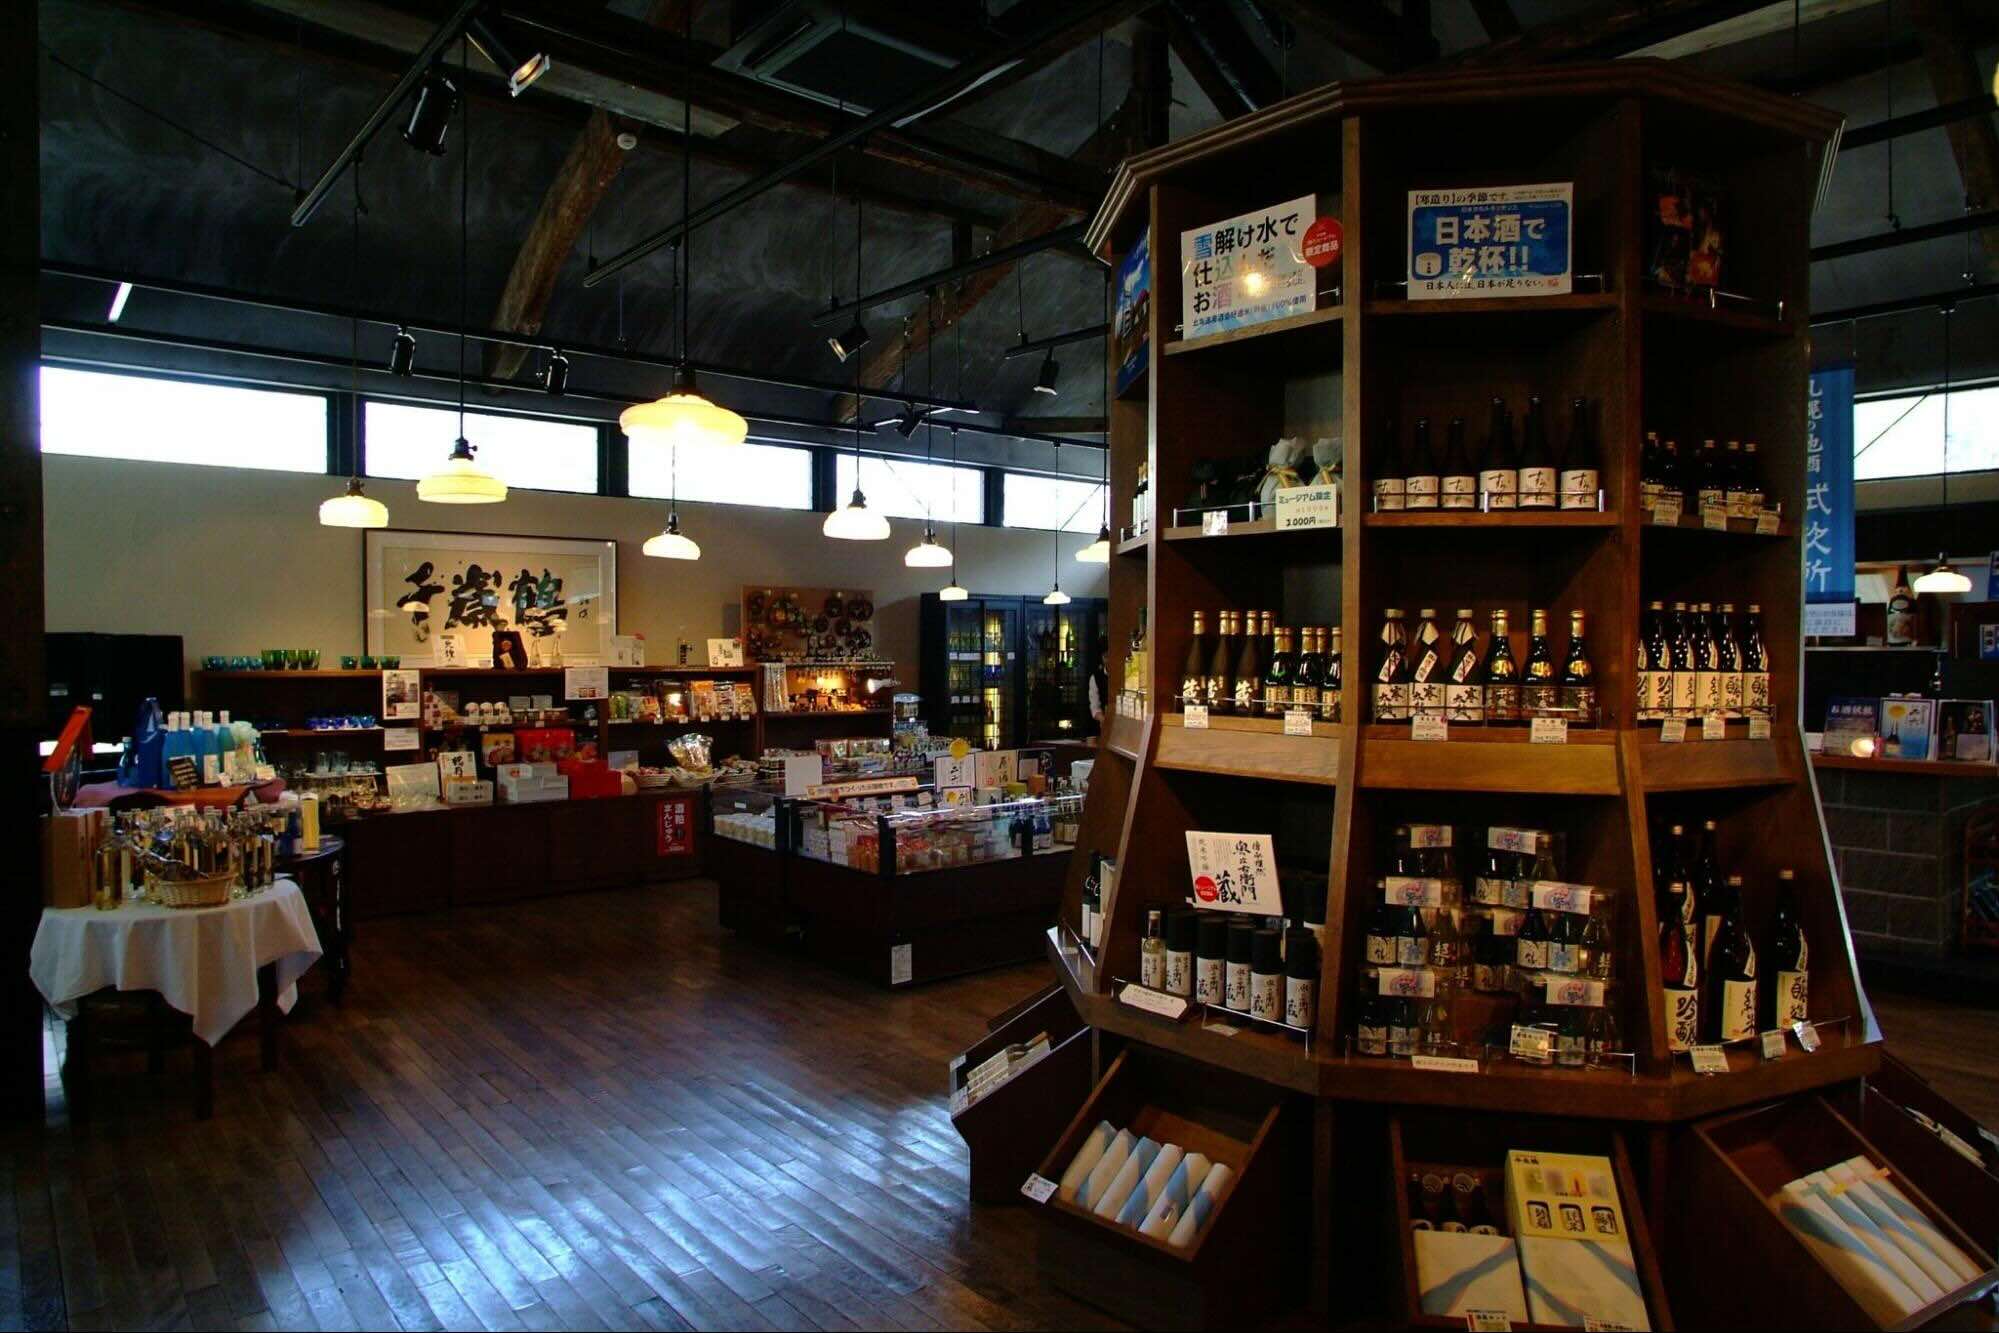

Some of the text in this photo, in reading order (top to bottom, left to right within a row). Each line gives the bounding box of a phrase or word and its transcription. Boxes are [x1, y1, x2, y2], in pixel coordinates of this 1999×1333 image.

[1194, 213, 1299, 260] 雪解け水で
[1435, 213, 1546, 246] 日本酒で
[1215, 869, 1242, 905] 蔵
